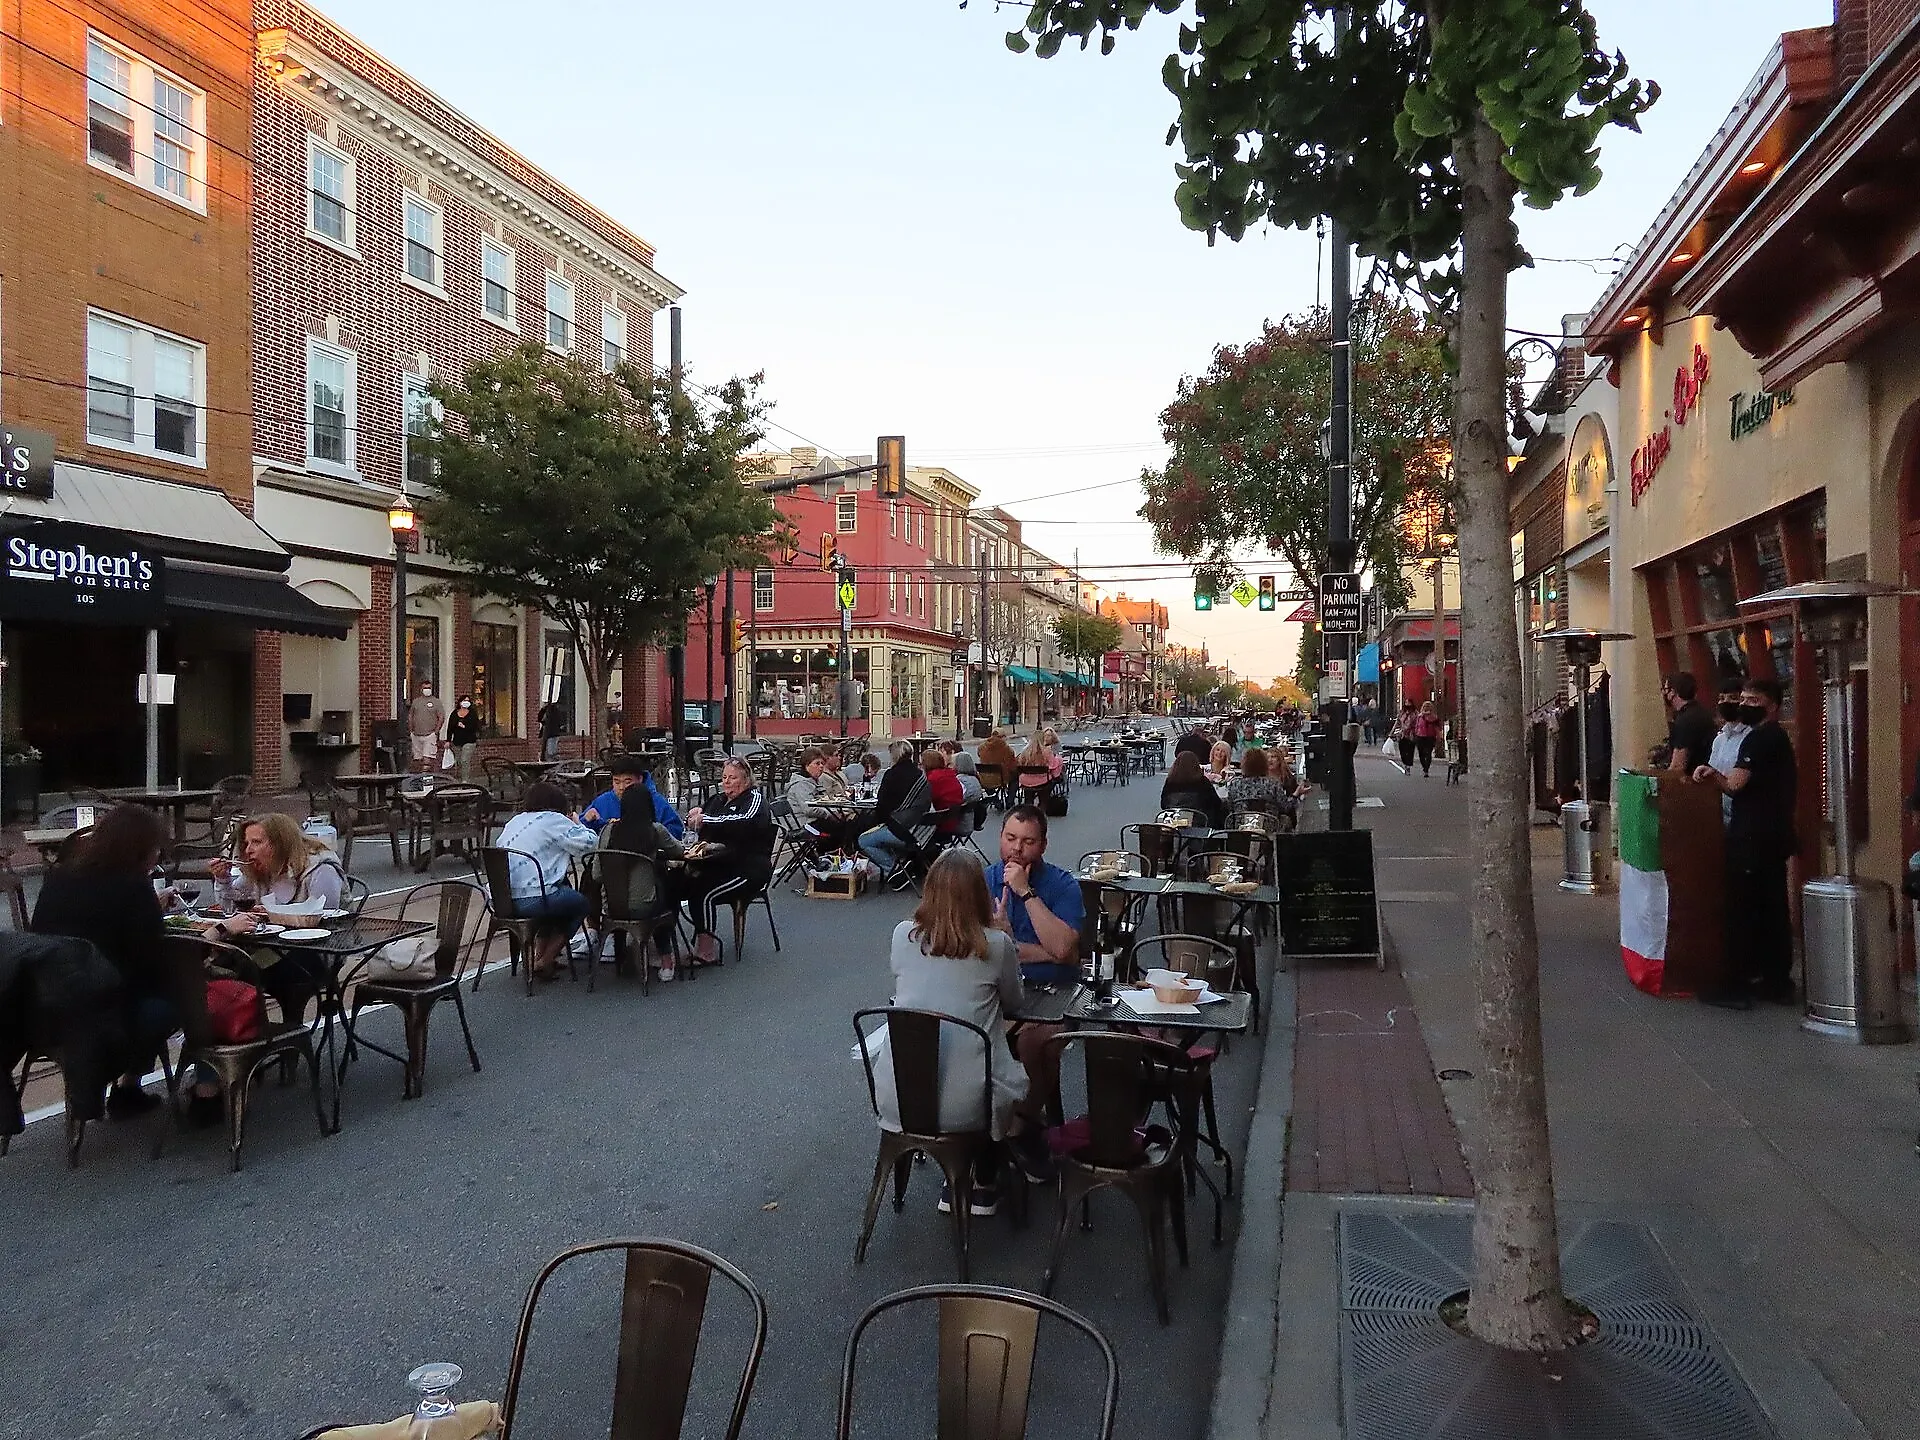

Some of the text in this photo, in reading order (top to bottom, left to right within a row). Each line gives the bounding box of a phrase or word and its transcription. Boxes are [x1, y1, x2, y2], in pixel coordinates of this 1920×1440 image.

[9, 537, 153, 580] Stephen's
[74, 575, 150, 591] on state
[1333, 578, 1348, 590] NO
[76, 594, 95, 603] 105
[1323, 593, 1359, 605] PARKING
[1325, 620, 1357, 628] MON-FRI
